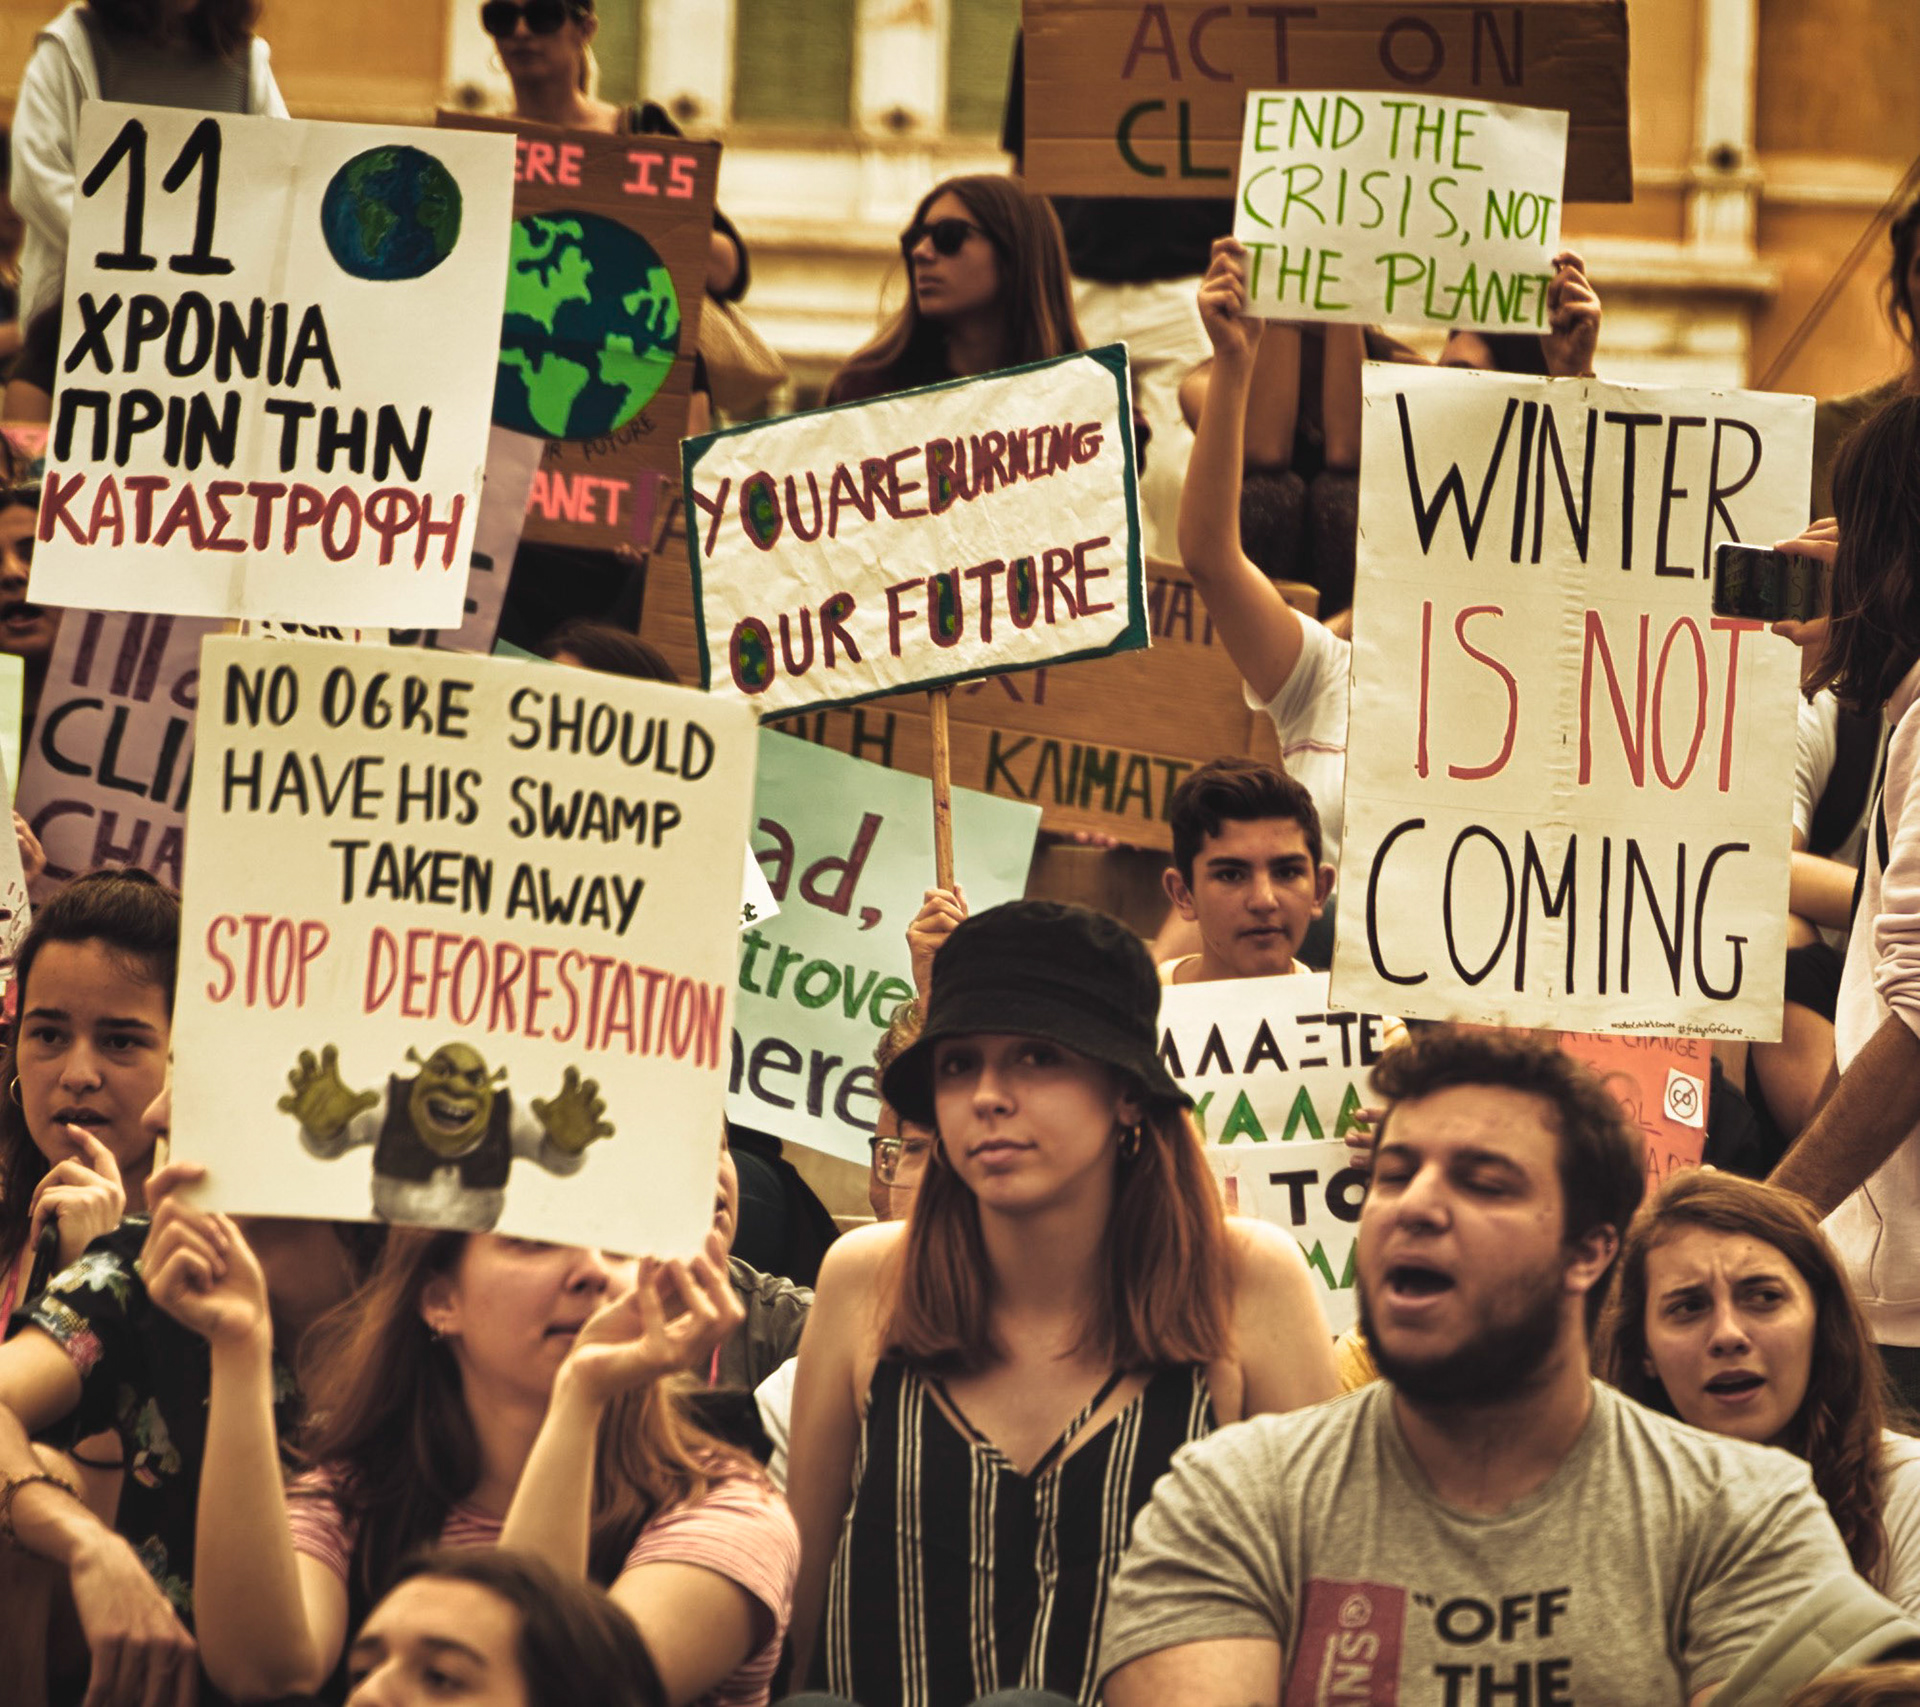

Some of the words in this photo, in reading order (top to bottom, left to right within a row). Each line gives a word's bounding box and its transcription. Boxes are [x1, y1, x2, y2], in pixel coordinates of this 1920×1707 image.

[1121, 3, 1317, 84] ACT
[1379, 8, 1524, 87] ON
[622, 150, 698, 199] IS
[1255, 95, 1364, 153] END
[1381, 101, 1488, 172] THE
[82, 118, 235, 275] 11
[1244, 163, 1471, 247] CRISIS,
[1484, 189, 1556, 247] NOT
[1245, 242, 1352, 311] THE
[1376, 251, 1553, 328] PLANET
[65, 289, 340, 389] ΧΡΟΝΙΑ
[53, 389, 241, 471] ΠΡΙΝ
[266, 398, 432, 482] ΤΗΝ
[582, 415, 657, 461] FUTURE
[37, 471, 465, 571] ΚΑΤΑΣΤΡΟΦΗ
[693, 470, 823, 557] YOU
[828, 447, 928, 538] ARE
[926, 423, 1104, 516] BURNING
[1396, 393, 1762, 580] WINTER
[729, 591, 862, 694] OUR
[885, 536, 1115, 657] FUTURE
[223, 663, 299, 730] NO
[321, 666, 473, 739] OGRE
[509, 687, 715, 782] SHOULD
[1414, 600, 1519, 780] IS
[1578, 609, 1765, 792] NOT
[41, 697, 196, 813] CLI
[222, 748, 384, 820] HAVE
[397, 762, 481, 826] HIS
[509, 775, 682, 848] SWAMP
[331, 840, 493, 914] TAKEN
[506, 863, 645, 936] AWAY
[1365, 818, 1750, 1001] COMING
[206, 914, 329, 1010] STOP
[363, 926, 725, 1070] DEFORESTATION
[1435, 1658, 1573, 1707] THE
